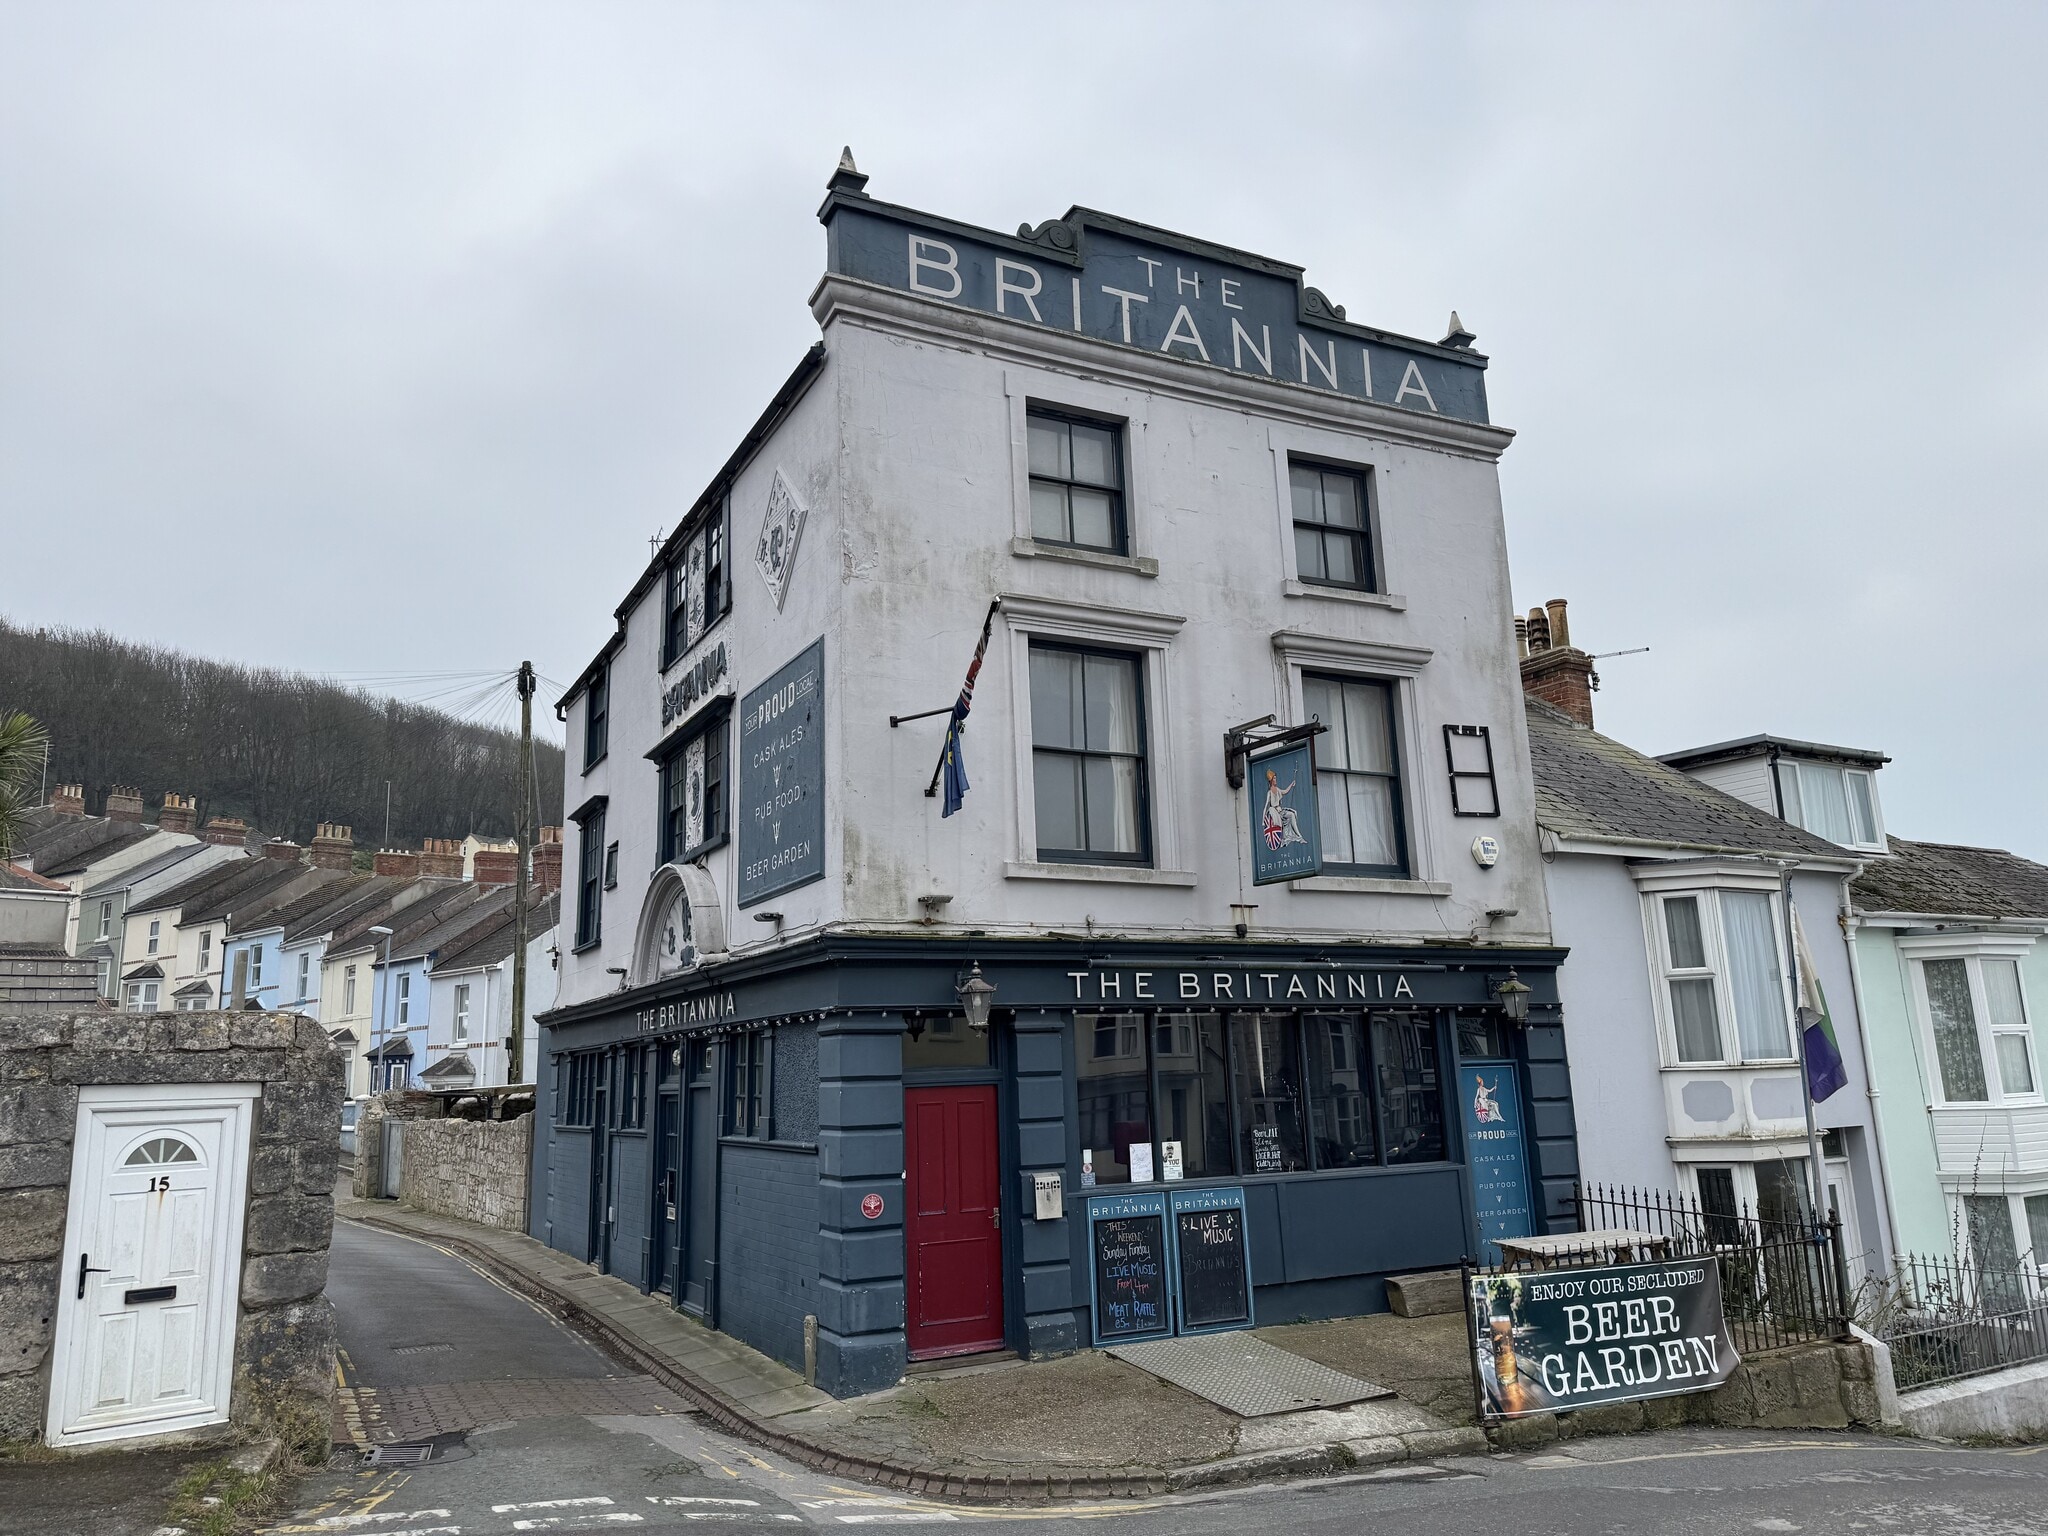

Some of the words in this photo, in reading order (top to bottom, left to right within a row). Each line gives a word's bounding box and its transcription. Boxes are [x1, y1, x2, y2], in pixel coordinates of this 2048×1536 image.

[1138, 256, 1244, 311] THE
[908, 233, 1439, 413] BRITANNIA
[745, 715, 758, 731] YOUR
[759, 681, 794, 729] PROUD
[796, 675, 814, 696] LOCAL
[753, 741, 776, 768] CASK
[779, 725, 803, 753] ALES
[755, 800, 772, 822] PUB
[775, 785, 800, 812] FOOD
[746, 859, 769, 881] BEER
[771, 840, 810, 870] GARDEN
[1260, 855, 1313, 872] BRITANNIA
[1067, 972, 1155, 998] THE
[1179, 972, 1414, 999] BRITANNIA
[636, 1009, 656, 1032] THE
[660, 992, 735, 1028] BRITANNIA
[1477, 1130, 1506, 1140] PROUD
[148, 1176, 170, 1192] 15
[1479, 1182, 1494, 1190] PUB
[1092, 1203, 1162, 1216] BRITANNIA
[1175, 1197, 1241, 1210] BRITANNIA
[1496, 1207, 1527, 1216] GARDEN
[1106, 1221, 1127, 1231] THIS
[1190, 1214, 1219, 1230] LIVE
[1203, 1228, 1234, 1245] MUSIC
[1106, 1265, 1130, 1278] LIVE
[1130, 1262, 1158, 1278] MUSIC
[1531, 1280, 1586, 1301] ENJOY
[1589, 1277, 1624, 1296] OUR
[1627, 1268, 1705, 1293] SECLUDED
[1108, 1301, 1129, 1317] MEAT
[1562, 1295, 1680, 1345] BEER
[1541, 1334, 1720, 1397] GARDEN
